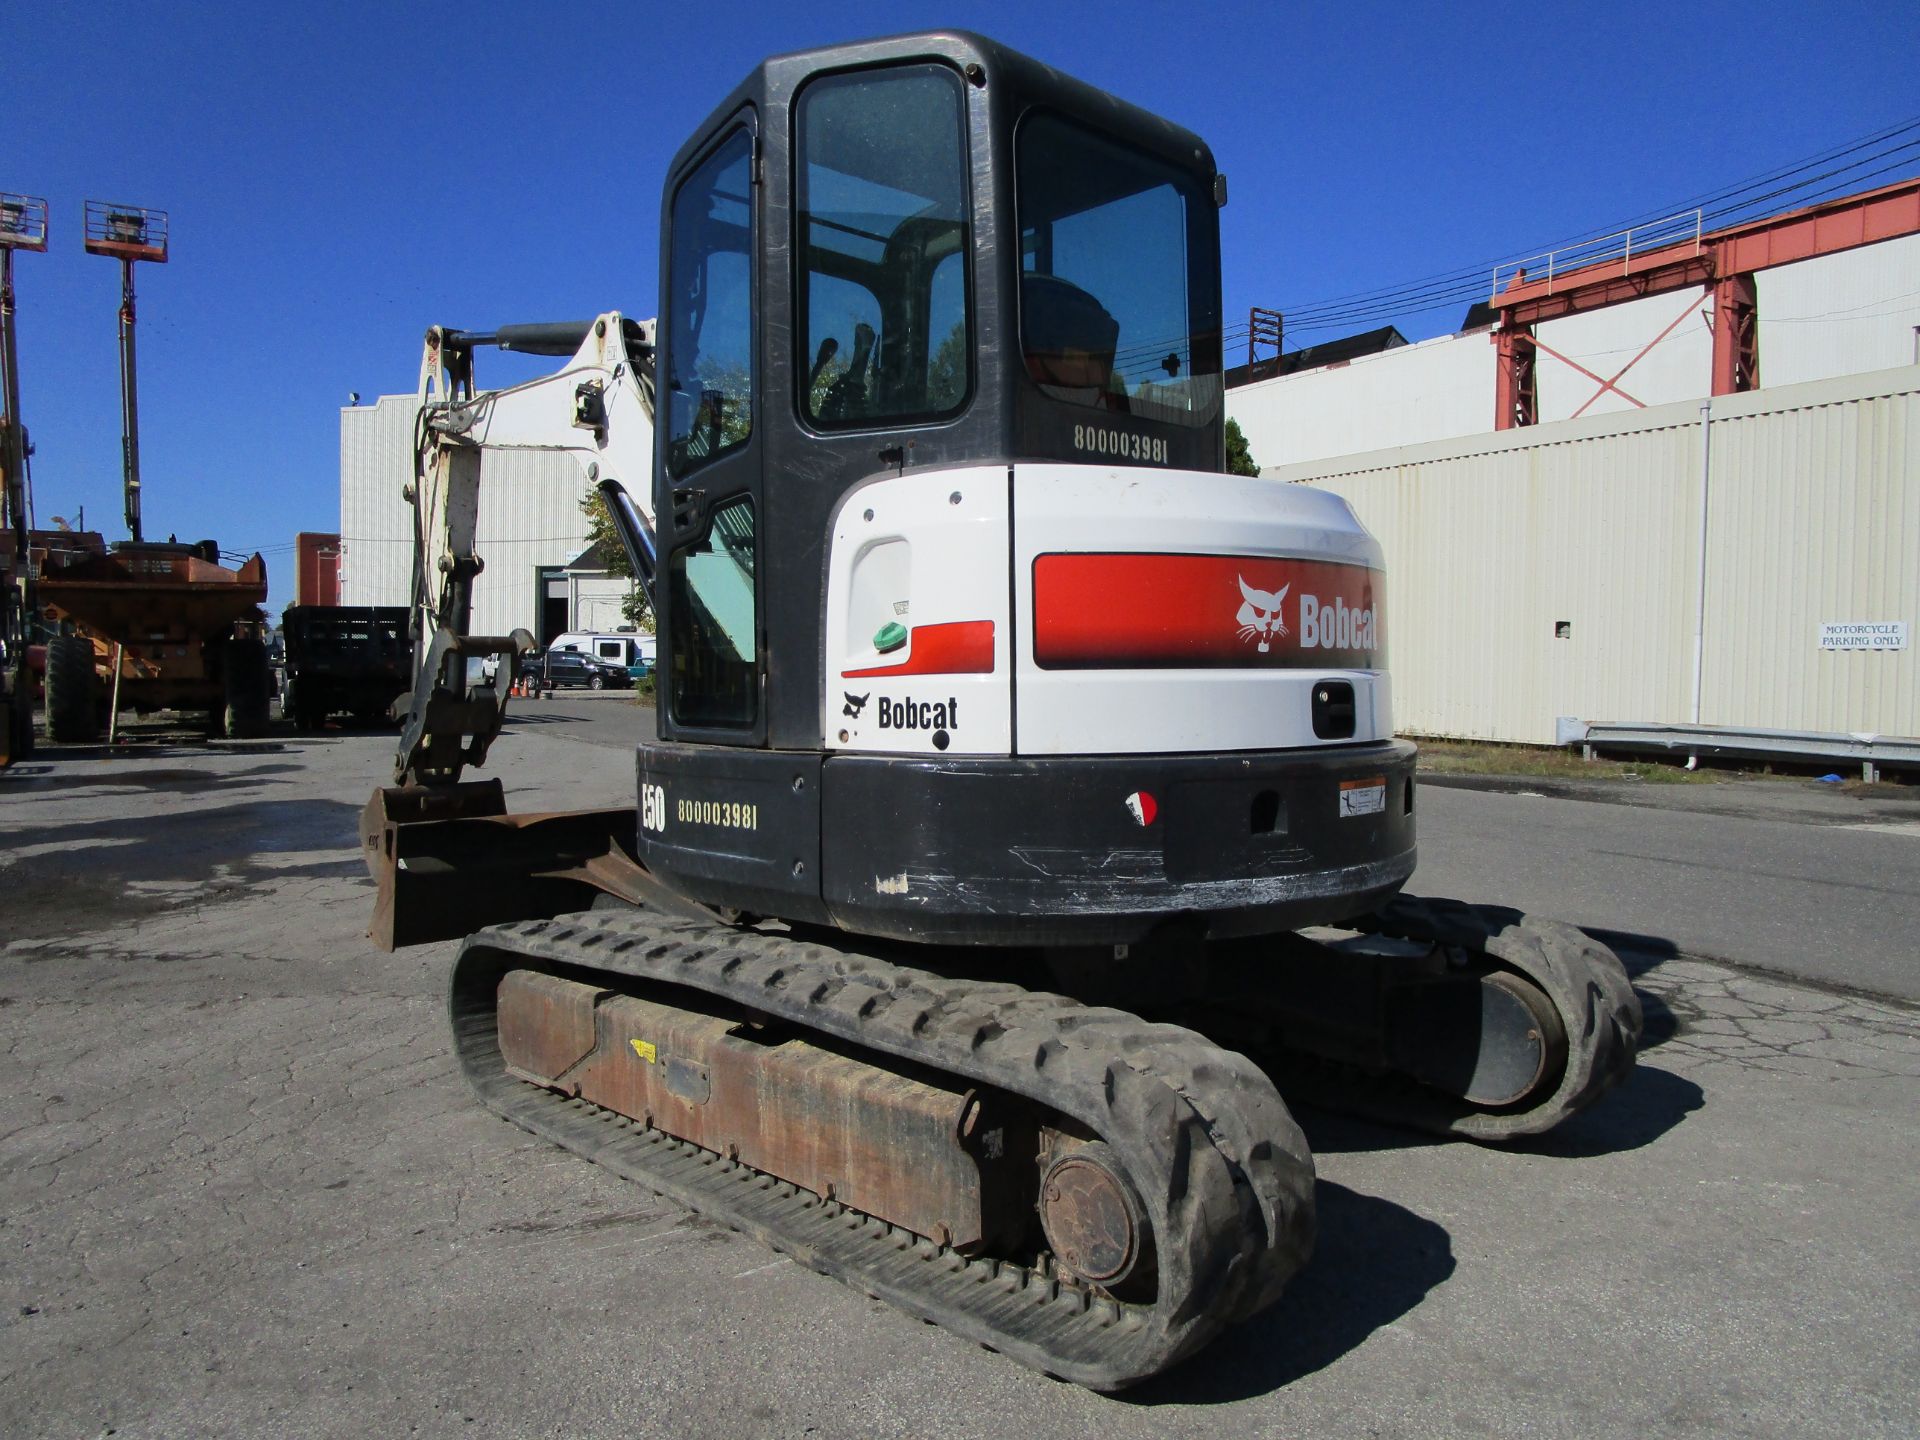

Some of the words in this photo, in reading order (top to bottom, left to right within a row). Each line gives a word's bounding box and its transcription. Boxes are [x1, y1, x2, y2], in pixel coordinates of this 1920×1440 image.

[1074, 424, 1168, 464] 800003981
[1300, 594, 1377, 650] Bobcat
[1826, 625, 1899, 634] MOTORCYCLE
[1822, 637, 1870, 645] PARKING
[1873, 636, 1902, 645] ONLY
[878, 696, 958, 730] Bobcat
[642, 783, 666, 832] E50
[678, 799, 757, 830] 800003981
